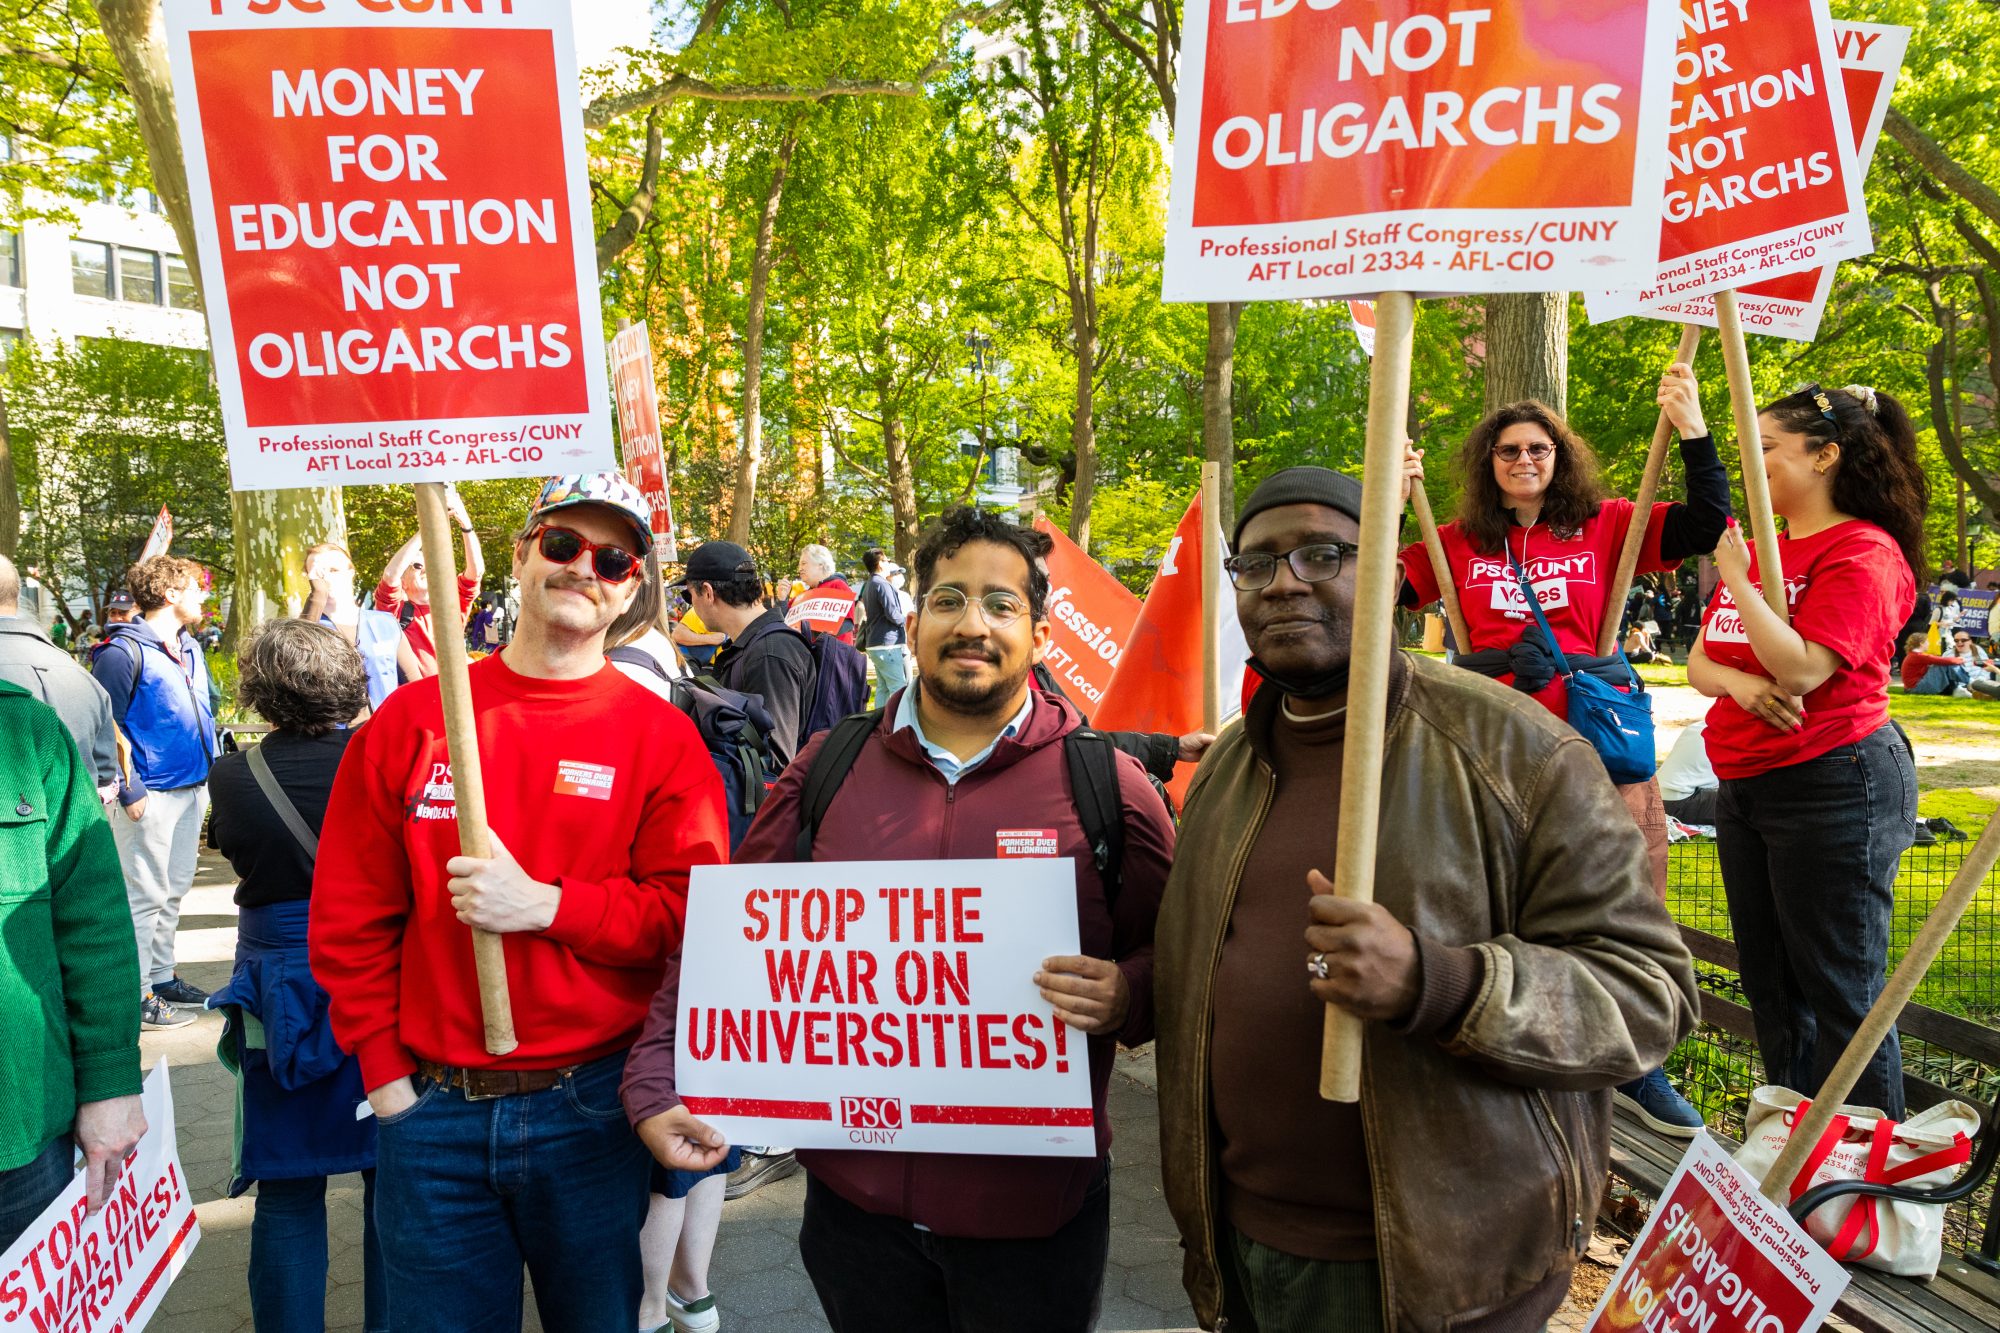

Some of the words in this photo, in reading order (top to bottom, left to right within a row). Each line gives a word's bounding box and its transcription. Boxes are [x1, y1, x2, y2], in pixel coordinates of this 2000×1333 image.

[1677, 0, 1749, 40] NEY
[1337, 9, 1491, 82] NOT
[1673, 42, 1733, 85] OR
[271, 67, 485, 118] MONEY
[1666, 63, 1815, 134] CATION
[1212, 82, 1622, 170] OLIGARCHS
[327, 133, 447, 183] FOR
[1665, 127, 1747, 180] NOT
[1661, 152, 1832, 223] GARCHS
[229, 198, 558, 251] EDUCATION
[1199, 225, 1337, 258] Professional
[1343, 223, 1401, 248] Staff
[1406, 220, 1619, 249] Congress/CUNY
[1695, 251, 1728, 271] Staff
[1731, 221, 1845, 260] Congress/CUNY
[339, 263, 461, 312] NOT
[1247, 261, 1291, 282] AFT
[1296, 258, 1354, 279] Local
[1362, 251, 1424, 273] 2334
[1448, 251, 1555, 272] AFL-CIO
[1668, 273, 1706, 293] Local
[1709, 265, 1746, 282] 2334
[1758, 245, 1816, 271] AFL-CIO
[1684, 304, 1714, 317] 2334
[1740, 314, 1773, 325] L-CIO
[248, 323, 572, 379] OLIGARCHS
[259, 432, 373, 453] Professional
[379, 429, 423, 448] Staff
[427, 423, 583, 448] Congress/CUNY
[306, 456, 340, 472] AFT
[345, 455, 392, 471] Local
[397, 451, 446, 468] 2334
[465, 446, 543, 465] AFL-CIO
[802, 600, 820, 612] THE
[821, 601, 848, 613] RICH
[1500, 587, 1561, 604] Voes
[1715, 615, 1745, 634] Vote
[1044, 639, 1072, 669] AFT
[428, 763, 453, 784] PS
[431, 787, 455, 797] CUN
[742, 887, 866, 943] STOP
[878, 887, 984, 943] THE
[764, 948, 879, 1005] WAR
[895, 950, 970, 1006] ON
[688, 1007, 1070, 1073] UNIVERSITIES!
[842, 1098, 900, 1127] PSC
[849, 1130, 897, 1145] CUNY
[1693, 1159, 1742, 1220] Congress/CUNY
[1715, 1161, 1741, 1191] AFL-CIO
[1738, 1192, 1762, 1218] 2334
[1739, 1211, 1762, 1237] Staff
[1763, 1209, 1790, 1241] Local
[0, 1195, 88, 1322] STOP
[29, 1232, 101, 1330] WAR
[105, 1171, 137, 1245] ON
[63, 1162, 180, 1333] ERSITIES!
[1663, 1202, 1784, 1333] OLIGARCHS
[1760, 1235, 1820, 1294] Professional
[1786, 1233, 1809, 1260] AFT
[1623, 1269, 1681, 1333] ATION
[1666, 1272, 1718, 1333] NOT
